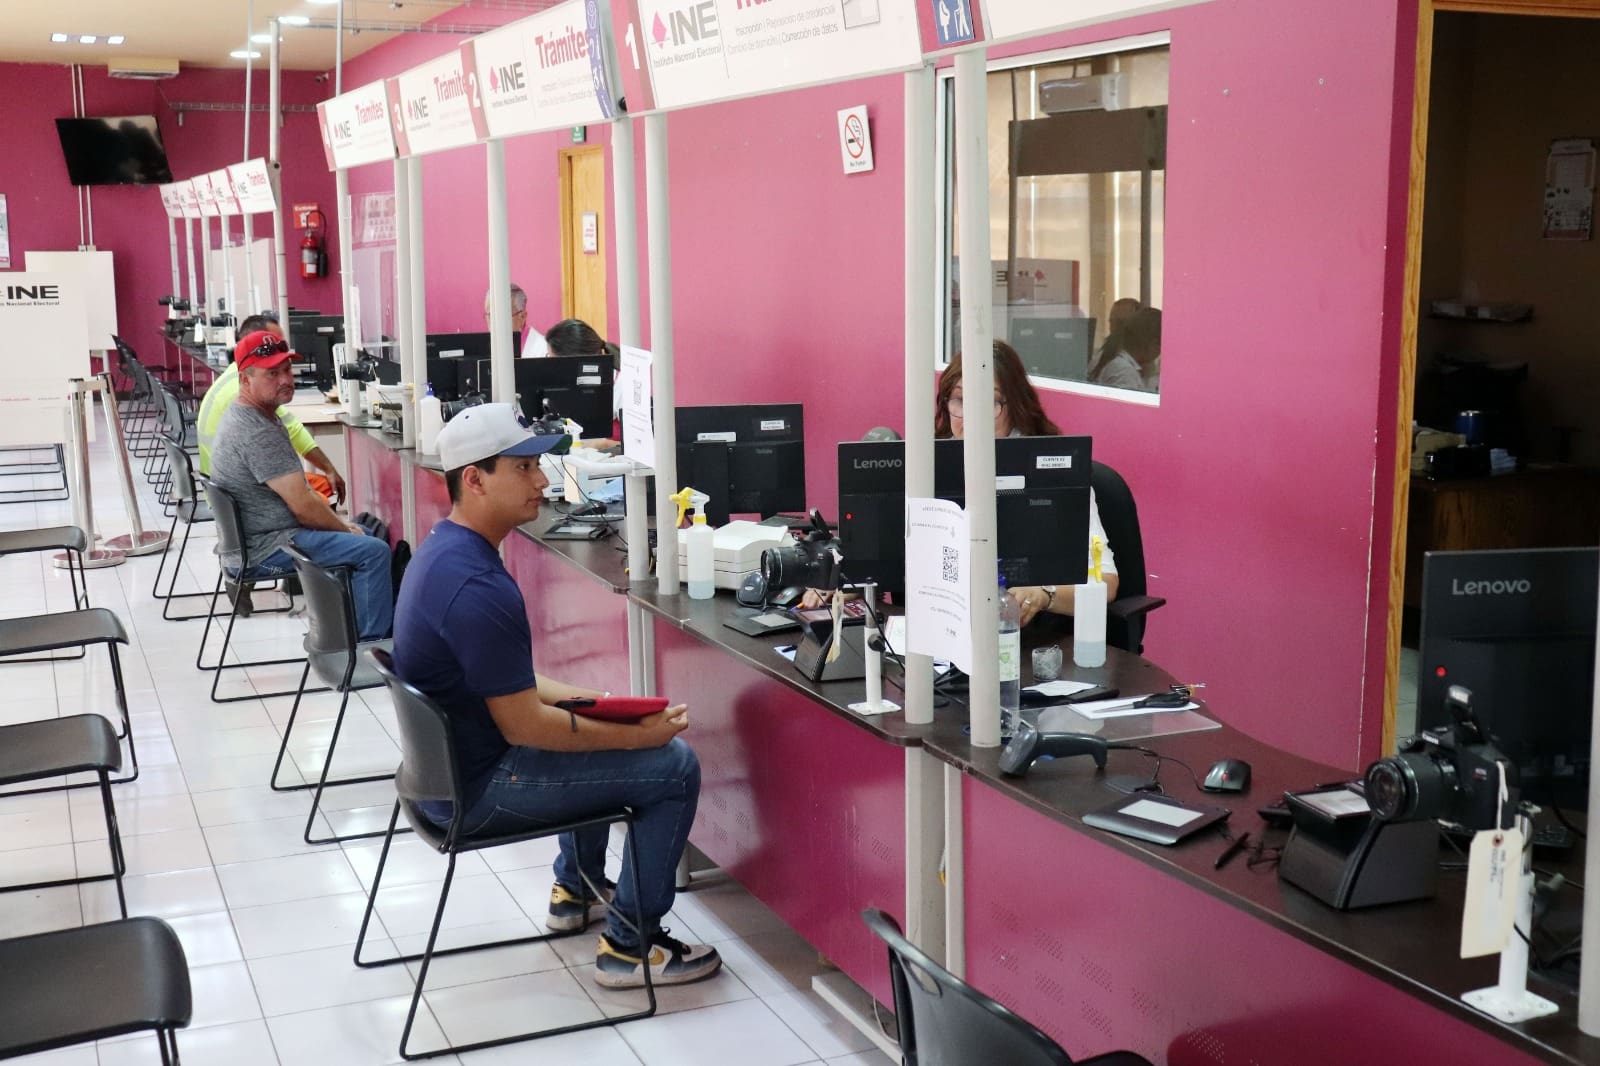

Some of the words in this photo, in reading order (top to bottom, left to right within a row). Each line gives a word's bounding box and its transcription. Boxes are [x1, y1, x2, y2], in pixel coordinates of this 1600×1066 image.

[669, 0, 718, 46] INE
[625, 23, 640, 69] 1
[433, 70, 465, 103] Trámit
[469, 72, 480, 108] 2
[499, 61, 525, 93] INE
[394, 103, 404, 132] 3
[412, 96, 429, 120] INE
[338, 120, 352, 139] INE
[7, 285, 59, 299] INE
[853, 459, 903, 469] Lenovo
[1452, 579, 1531, 595] Lenovo
